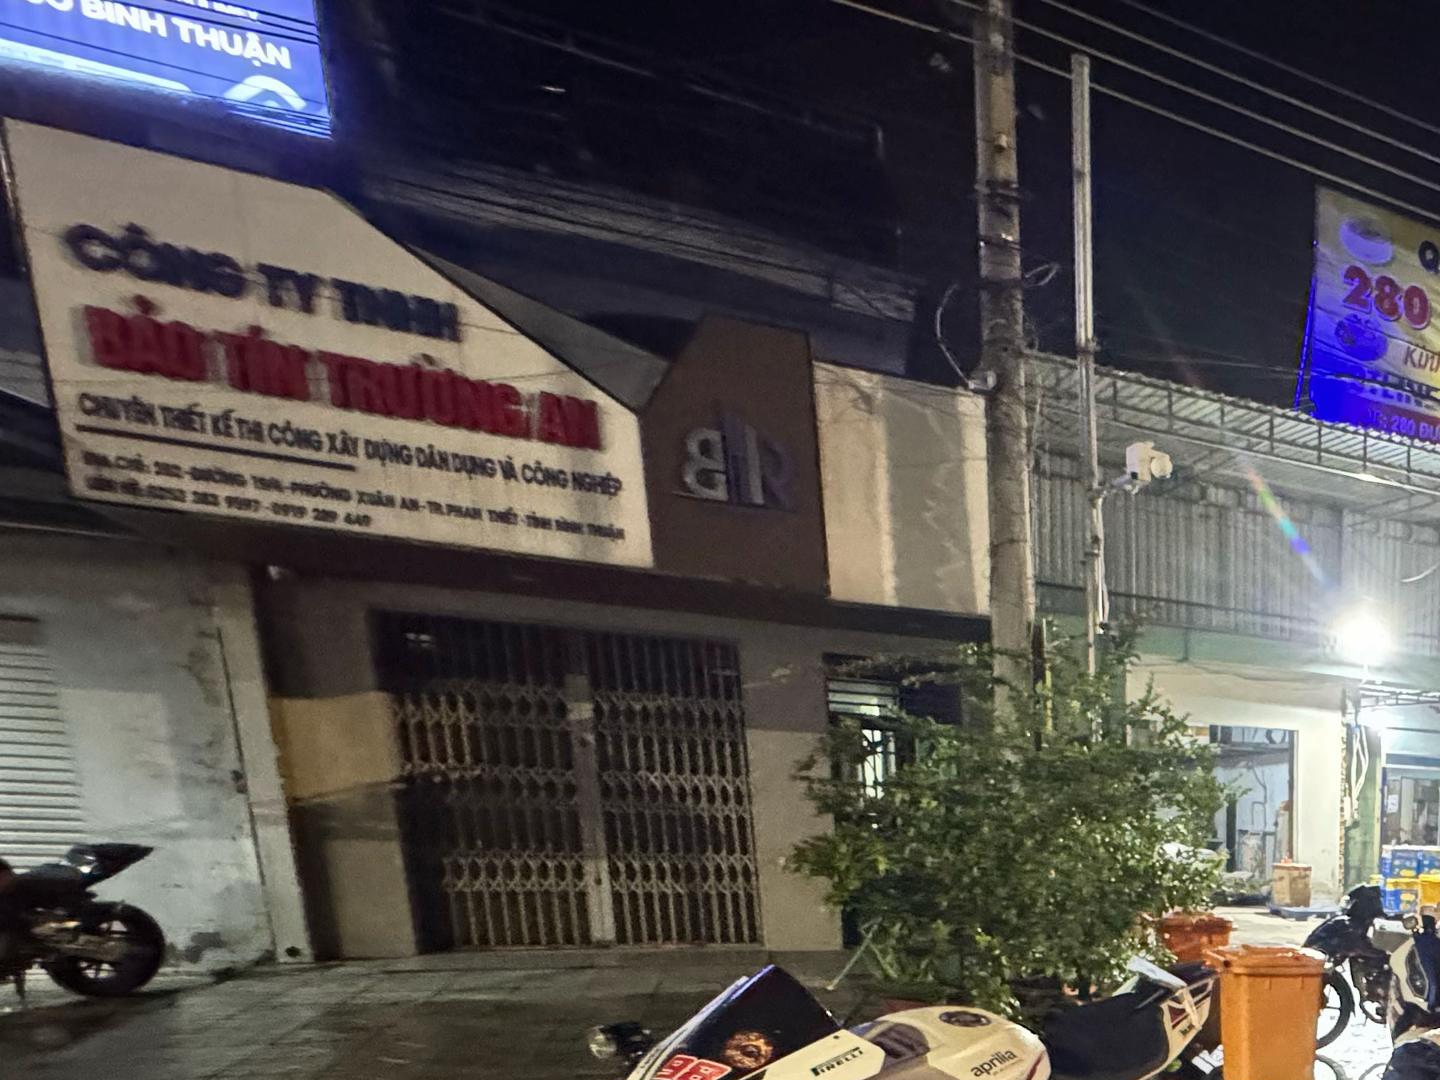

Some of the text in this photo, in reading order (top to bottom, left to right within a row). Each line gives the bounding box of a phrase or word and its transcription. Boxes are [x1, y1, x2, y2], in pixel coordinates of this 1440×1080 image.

[171, 17, 293, 69] THUẬN
[64, 222, 462, 343] CÔNG TY TNHH
[1342, 265, 1432, 330] 280
[212, 324, 311, 403] TÍN
[538, 391, 604, 450] AN
[79, 393, 158, 426] CHUYÊN
[160, 402, 207, 435] THIẾT
[210, 408, 236, 438] KẾ
[268, 420, 323, 451] CÔNG
[325, 429, 359, 457] XÂY
[364, 438, 413, 467] DỰNG
[415, 444, 450, 472] DÂN
[451, 452, 498, 480] DỰNG
[498, 455, 519, 483] VÀ
[521, 460, 569, 490] CÔNG
[571, 471, 624, 500] NGHIỆP
[810, 1046, 864, 1077] PIRELLI
[970, 1049, 1018, 1077] aprilia
